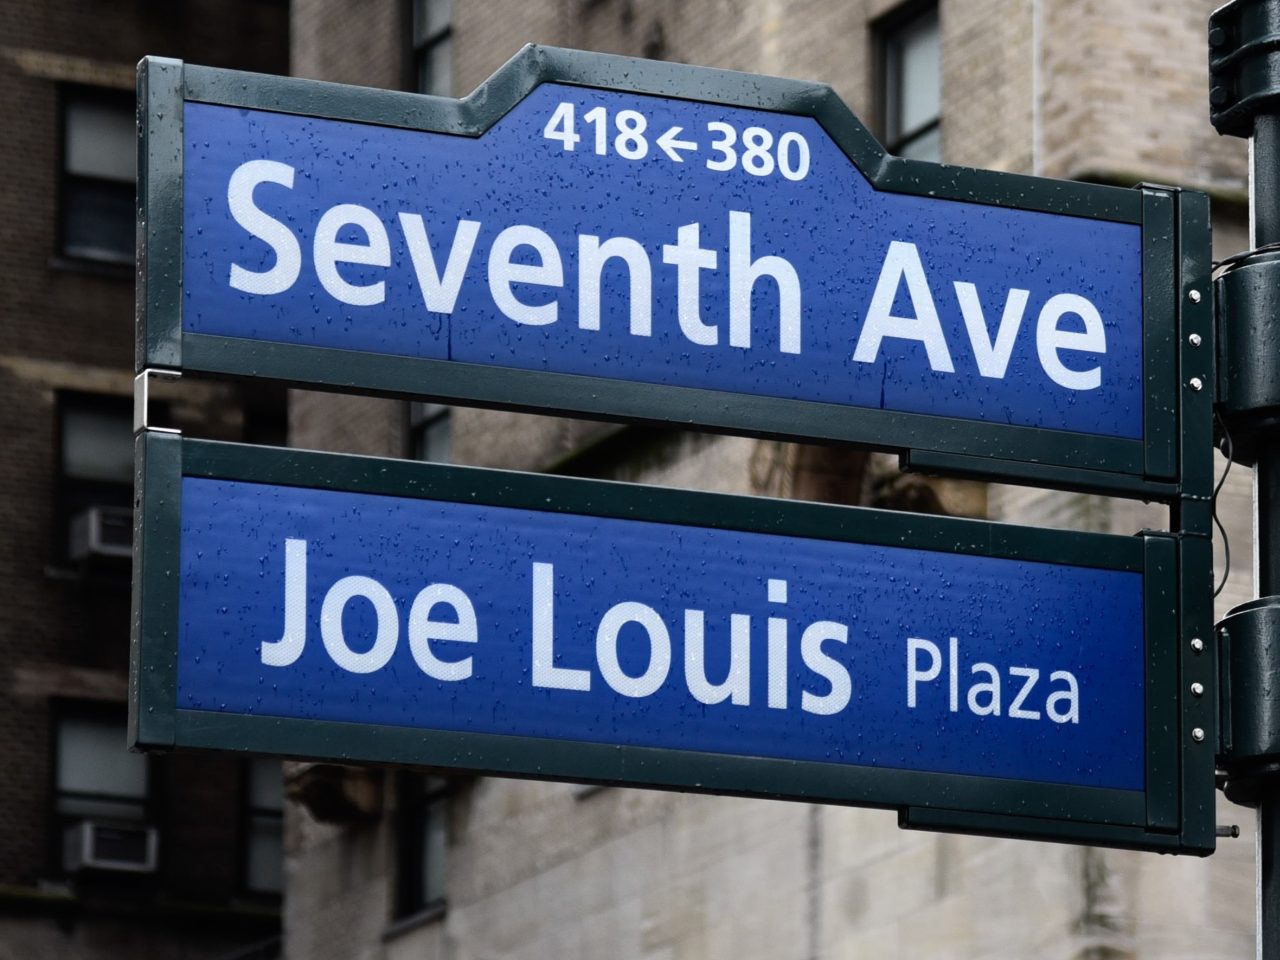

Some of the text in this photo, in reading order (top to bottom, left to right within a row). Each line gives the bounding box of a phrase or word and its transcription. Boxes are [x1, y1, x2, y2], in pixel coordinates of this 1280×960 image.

[543, 101, 811, 182] 418 380
[227, 159, 1107, 391] Seventh Ave
[261, 538, 1080, 725] Joe Louis Plaza
